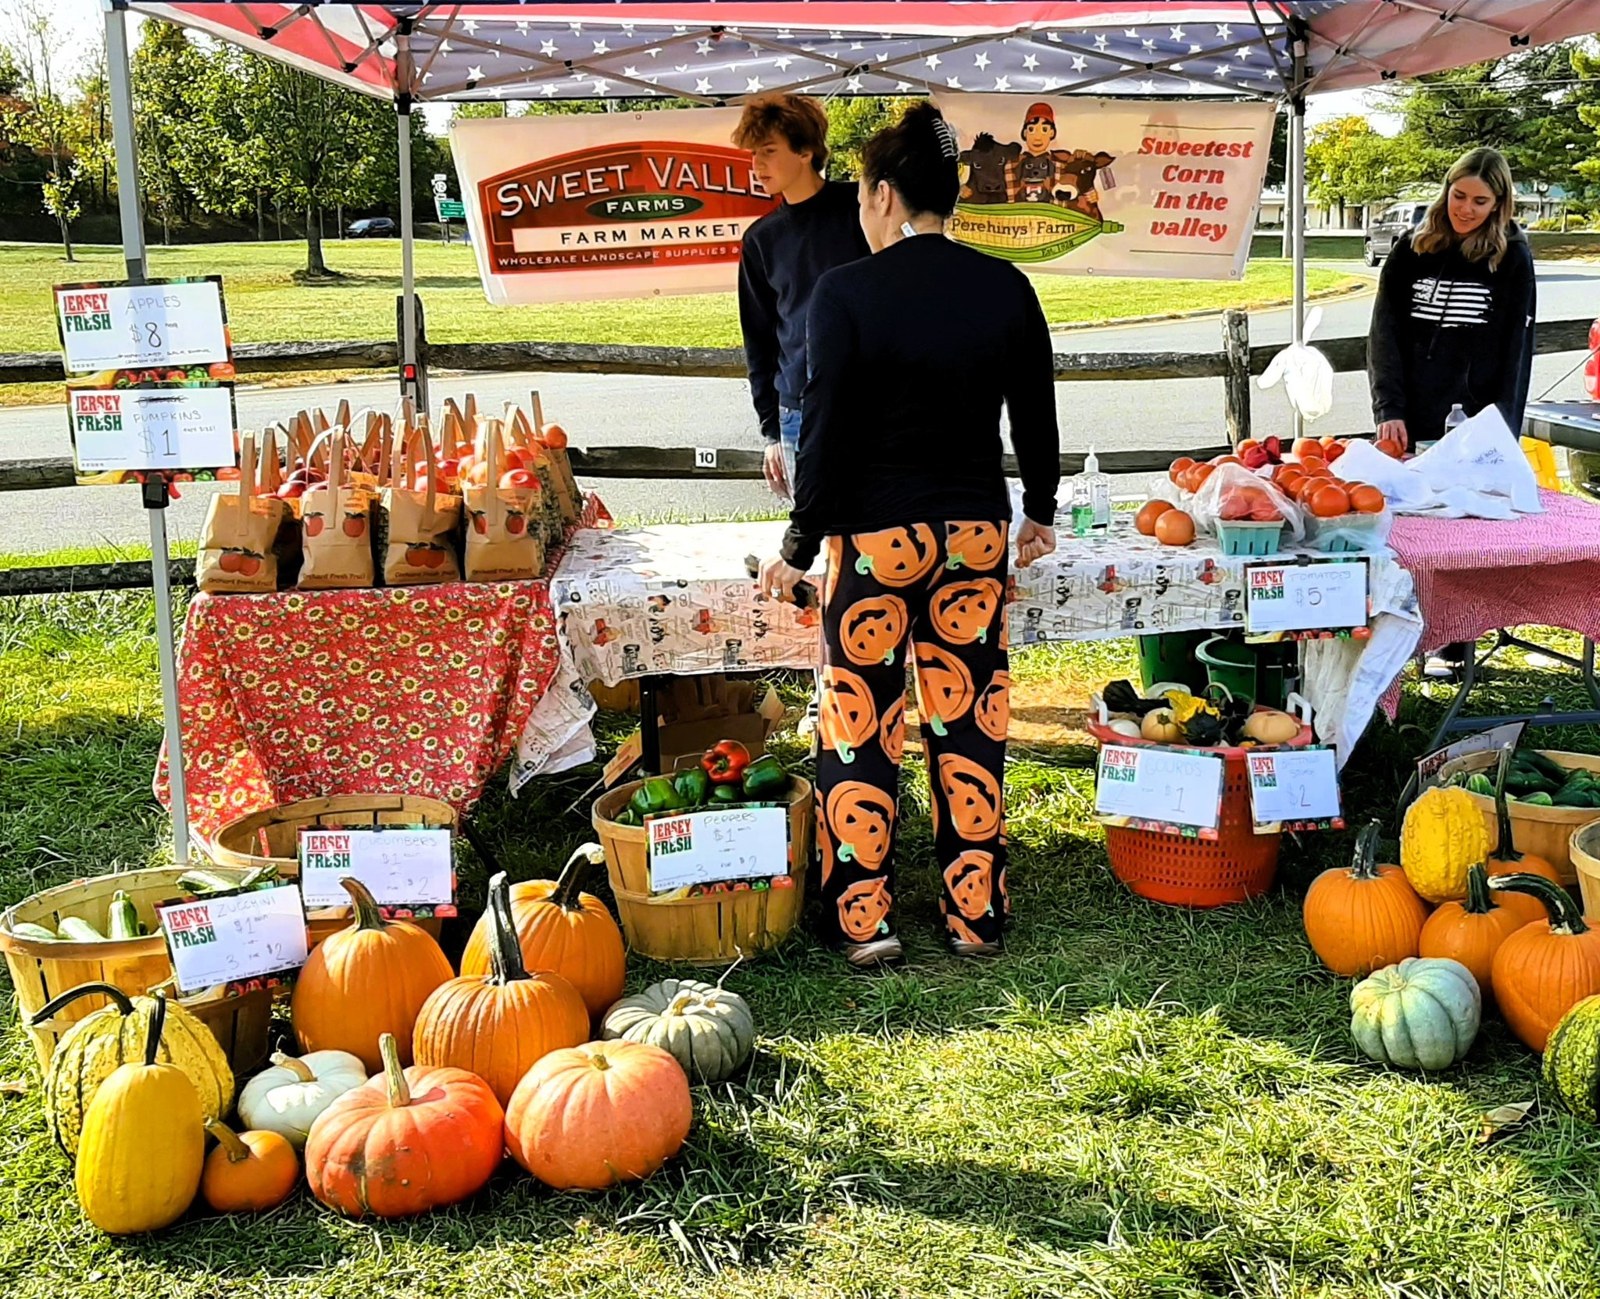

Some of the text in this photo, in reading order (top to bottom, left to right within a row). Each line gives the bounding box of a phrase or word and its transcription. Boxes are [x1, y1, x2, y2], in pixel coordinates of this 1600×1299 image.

[1137, 136, 1254, 158] Sweetest
[1162, 164, 1225, 184] Corn
[497, 156, 773, 217] SWEET VALLE
[606, 198, 686, 214] FARMS
[1154, 191, 1228, 211] In the
[561, 223, 740, 245] FARM MARKET
[1036, 221, 1076, 235] Farm
[1150, 217, 1228, 242] valley
[498, 254, 577, 267] WHOLESALE
[582, 250, 660, 263] LANDSCAPE
[665, 246, 726, 258] SUPPLIES
[63, 292, 108, 312] JERSEY
[125, 295, 181, 315] APPLES
[64, 312, 112, 333] FRESH
[76, 394, 121, 413] JERSEY
[77, 413, 122, 432] FRESH
[132, 409, 202, 424] PUMPKINS
[698, 451, 714, 464] 10
[1251, 570, 1284, 585] JERSEY
[1251, 585, 1284, 600] FRESH
[1103, 748, 1138, 766] JERSEY
[1101, 765, 1136, 783] FRESH
[653, 818, 691, 839] JERSEY
[306, 835, 350, 850] JERSEY
[653, 836, 692, 857] FRESH
[306, 853, 351, 868] FRESH
[166, 905, 211, 929] JERSEY
[171, 925, 218, 949] FRESH
